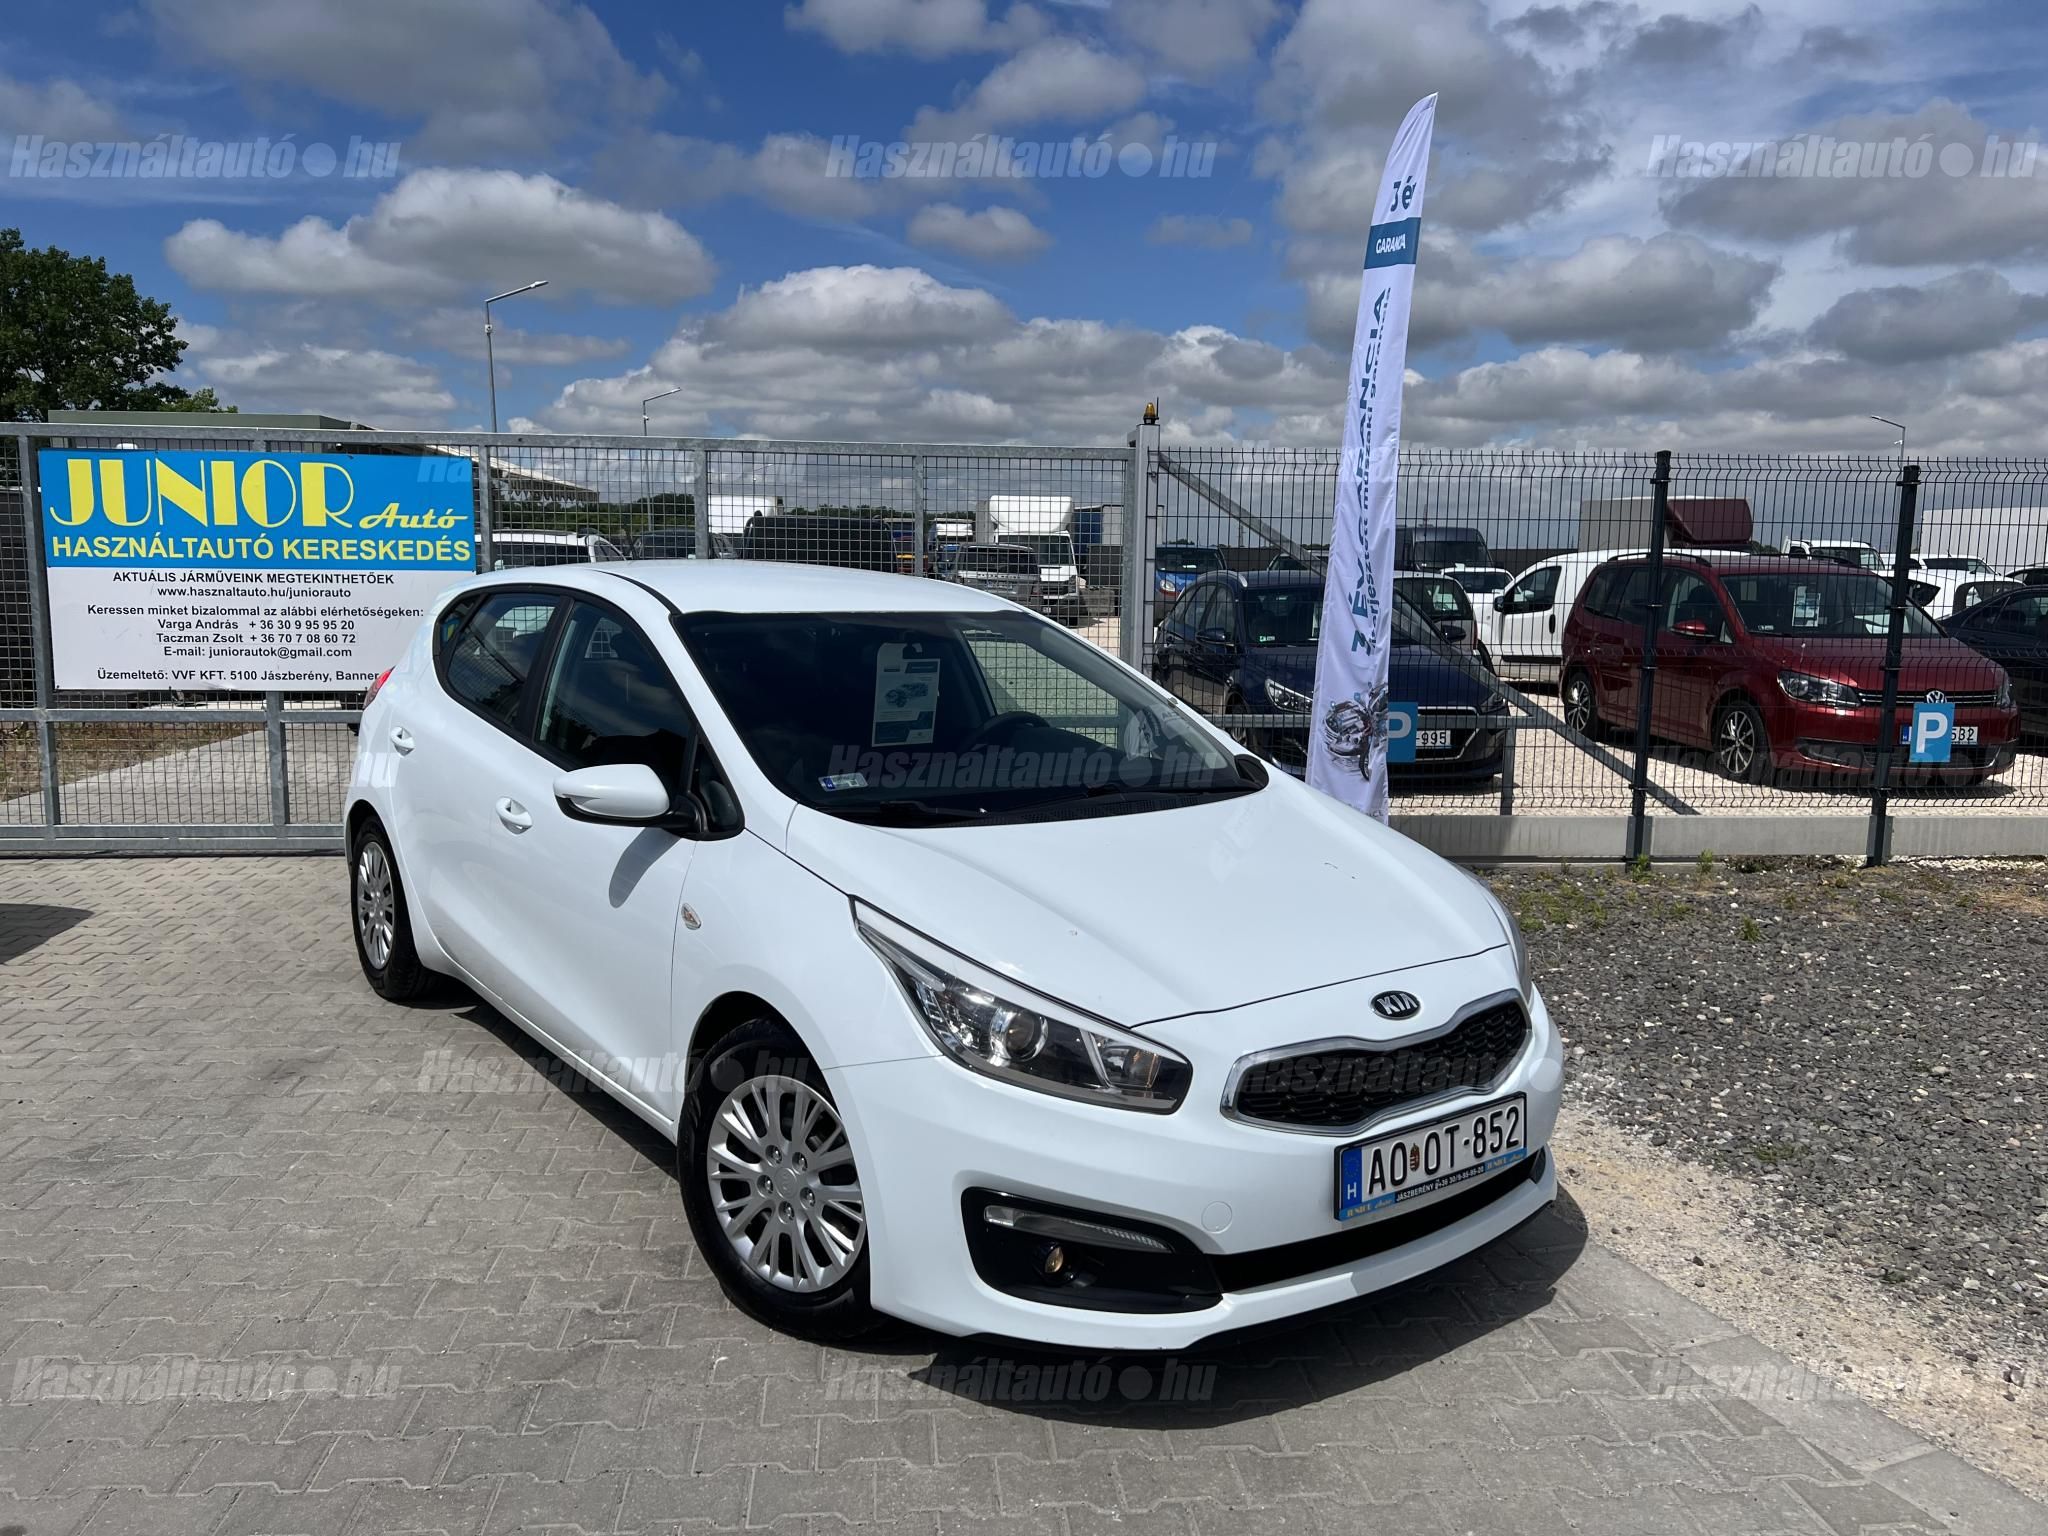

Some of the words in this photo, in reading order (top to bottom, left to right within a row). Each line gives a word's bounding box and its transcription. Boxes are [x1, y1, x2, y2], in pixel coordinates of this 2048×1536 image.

[50, 458, 354, 528] JUNIOR
[359, 502, 468, 529] Autó
[52, 532, 274, 560] HASZNÁLTAUTÓ
[283, 535, 471, 561] KERESKEDÉS
[112, 569, 177, 583] AKTUÁLIS
[179, 569, 264, 584] JÁRMŰVEINK
[266, 571, 395, 585] MEGTEKINTHETŐEK
[157, 586, 352, 600] www.hasznaltauto.hu/juniorauto
[87, 604, 144, 615] Keressen
[147, 605, 189, 616] minket
[191, 605, 260, 616] bizalommal
[263, 608, 278, 616] az
[280, 606, 317, 617] alábbi
[320, 606, 424, 620] elérhetőségeken:
[157, 618, 192, 632] Varga
[194, 619, 239, 630] András
[259, 619, 274, 630] 36
[277, 619, 291, 630] 30
[294, 619, 302, 630] 9
[305, 619, 320, 630] 95
[322, 619, 338, 630] 95
[340, 619, 355, 630] 20
[155, 632, 210, 643] Taczman
[212, 633, 244, 643] Zsolt
[260, 633, 275, 643] 36
[277, 633, 293, 644] 70
[295, 633, 303, 644] 7
[306, 633, 321, 644] 08
[323, 633, 339, 644] 60
[341, 633, 356, 644] 72
[163, 645, 206, 657] E-mail:
[208, 646, 353, 660] juniorautok@gmail.com
[97, 667, 169, 680] Üzemeltető:
[171, 669, 196, 681] VVF
[199, 670, 227, 681] KFT.
[230, 670, 258, 681] 5100
[260, 670, 332, 683] Jászberény,
[1916, 711, 1948, 753] P
[1377, 993, 1418, 1015] KIA
[1347, 1182, 1357, 1200] H
